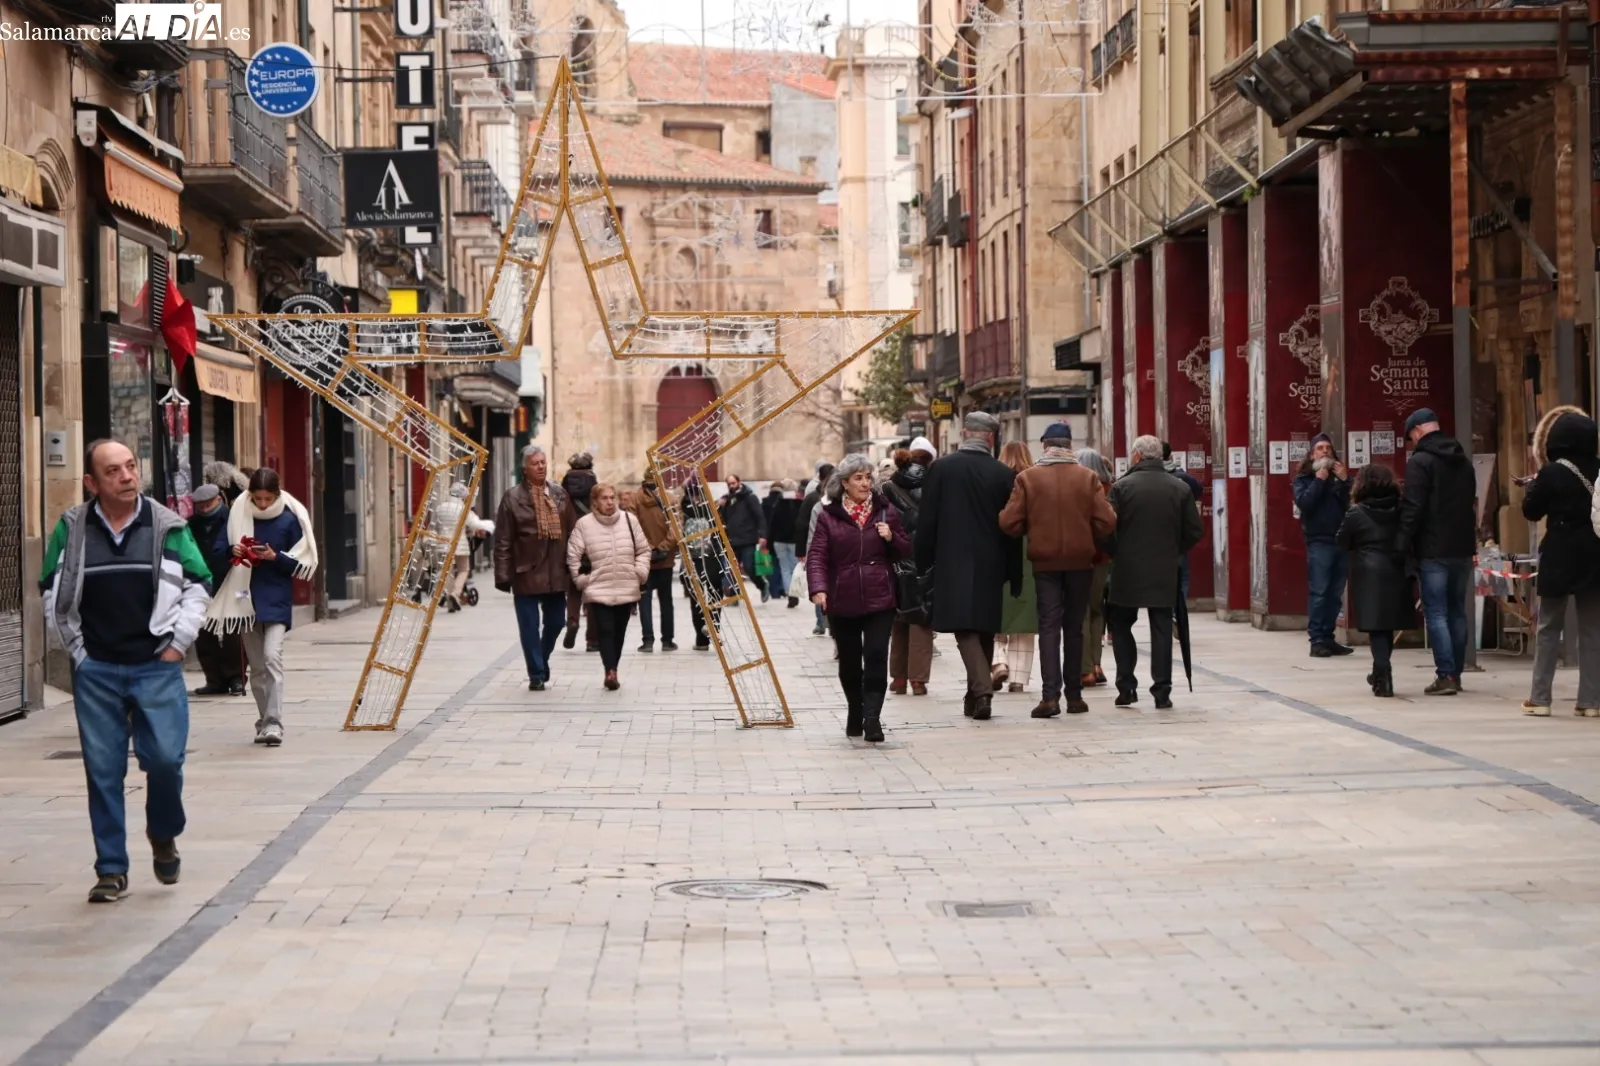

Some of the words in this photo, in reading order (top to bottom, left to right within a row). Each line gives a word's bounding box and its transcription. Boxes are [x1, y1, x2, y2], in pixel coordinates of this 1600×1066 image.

[260, 68, 314, 81] EUROPA
[261, 81, 297, 89] RESIDENCIA
[261, 86, 307, 95] UNIVERSITARIA
[1388, 357, 1411, 368] Junta
[1413, 356, 1426, 366] de
[1370, 365, 1429, 382] Semana
[1383, 378, 1429, 395] Santa
[1186, 402, 1210, 415] Sem
